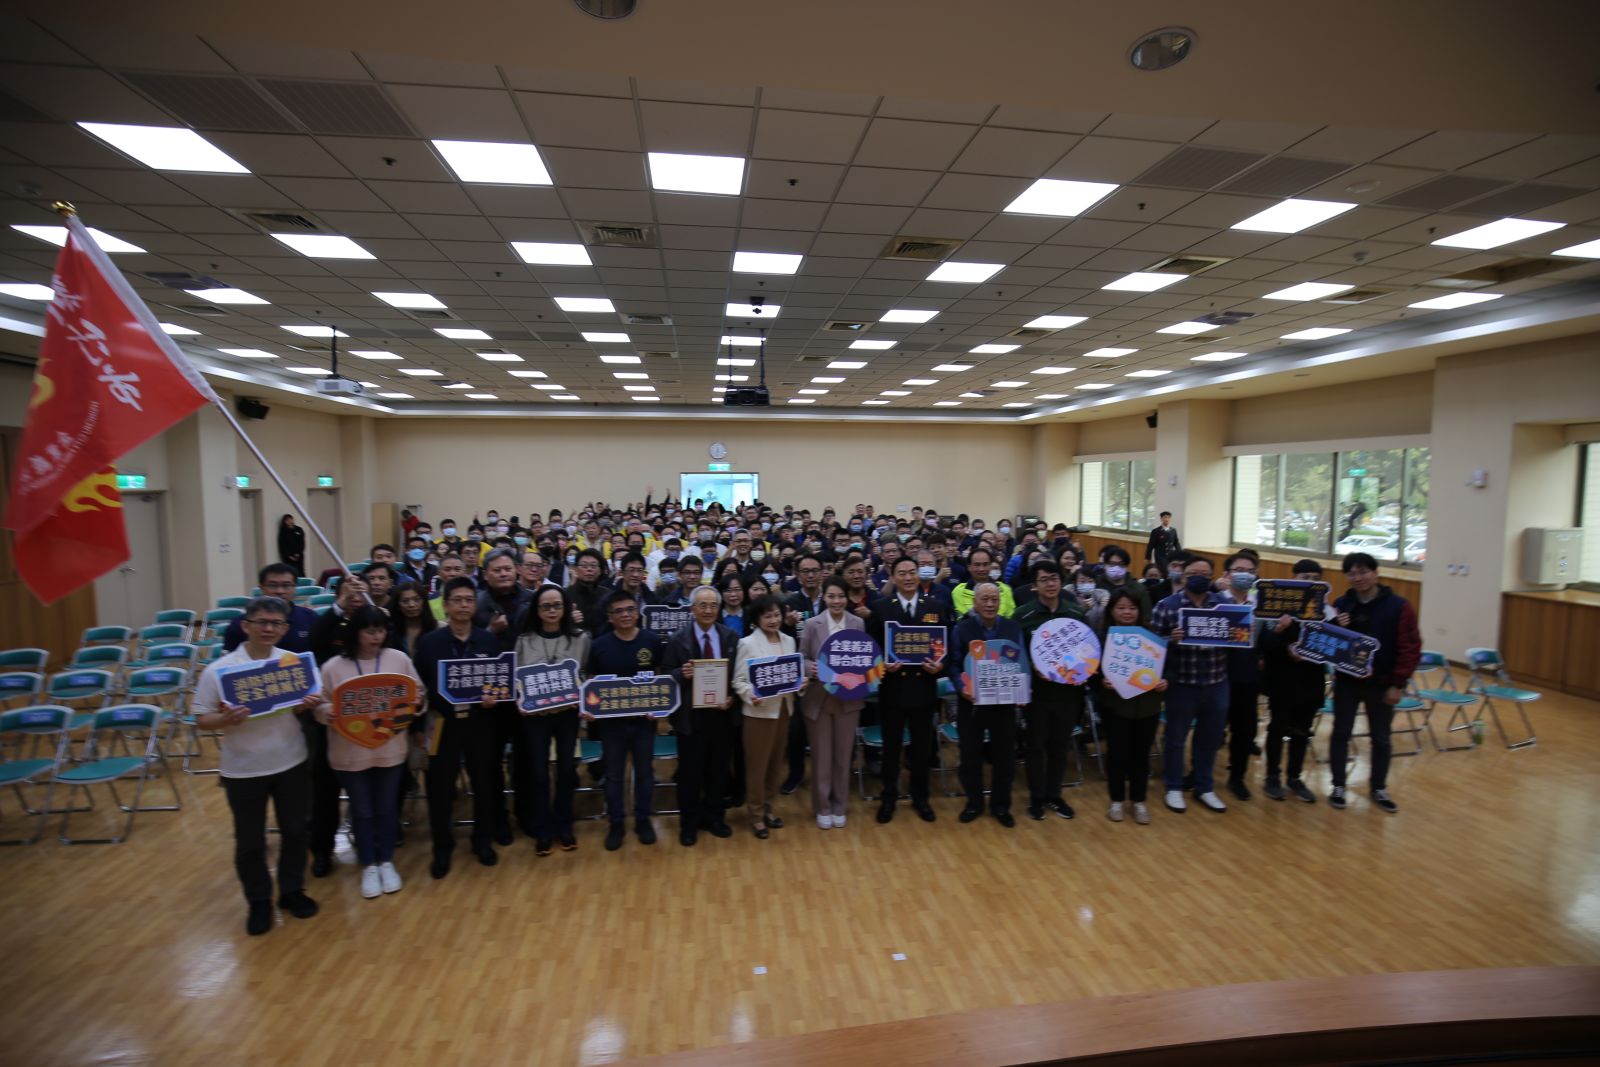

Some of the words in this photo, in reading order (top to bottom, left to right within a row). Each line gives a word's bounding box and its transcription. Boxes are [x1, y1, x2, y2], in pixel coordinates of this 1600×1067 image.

[830, 639, 873, 653] 企業義消
[829, 654, 873, 667] 聯合成軍
